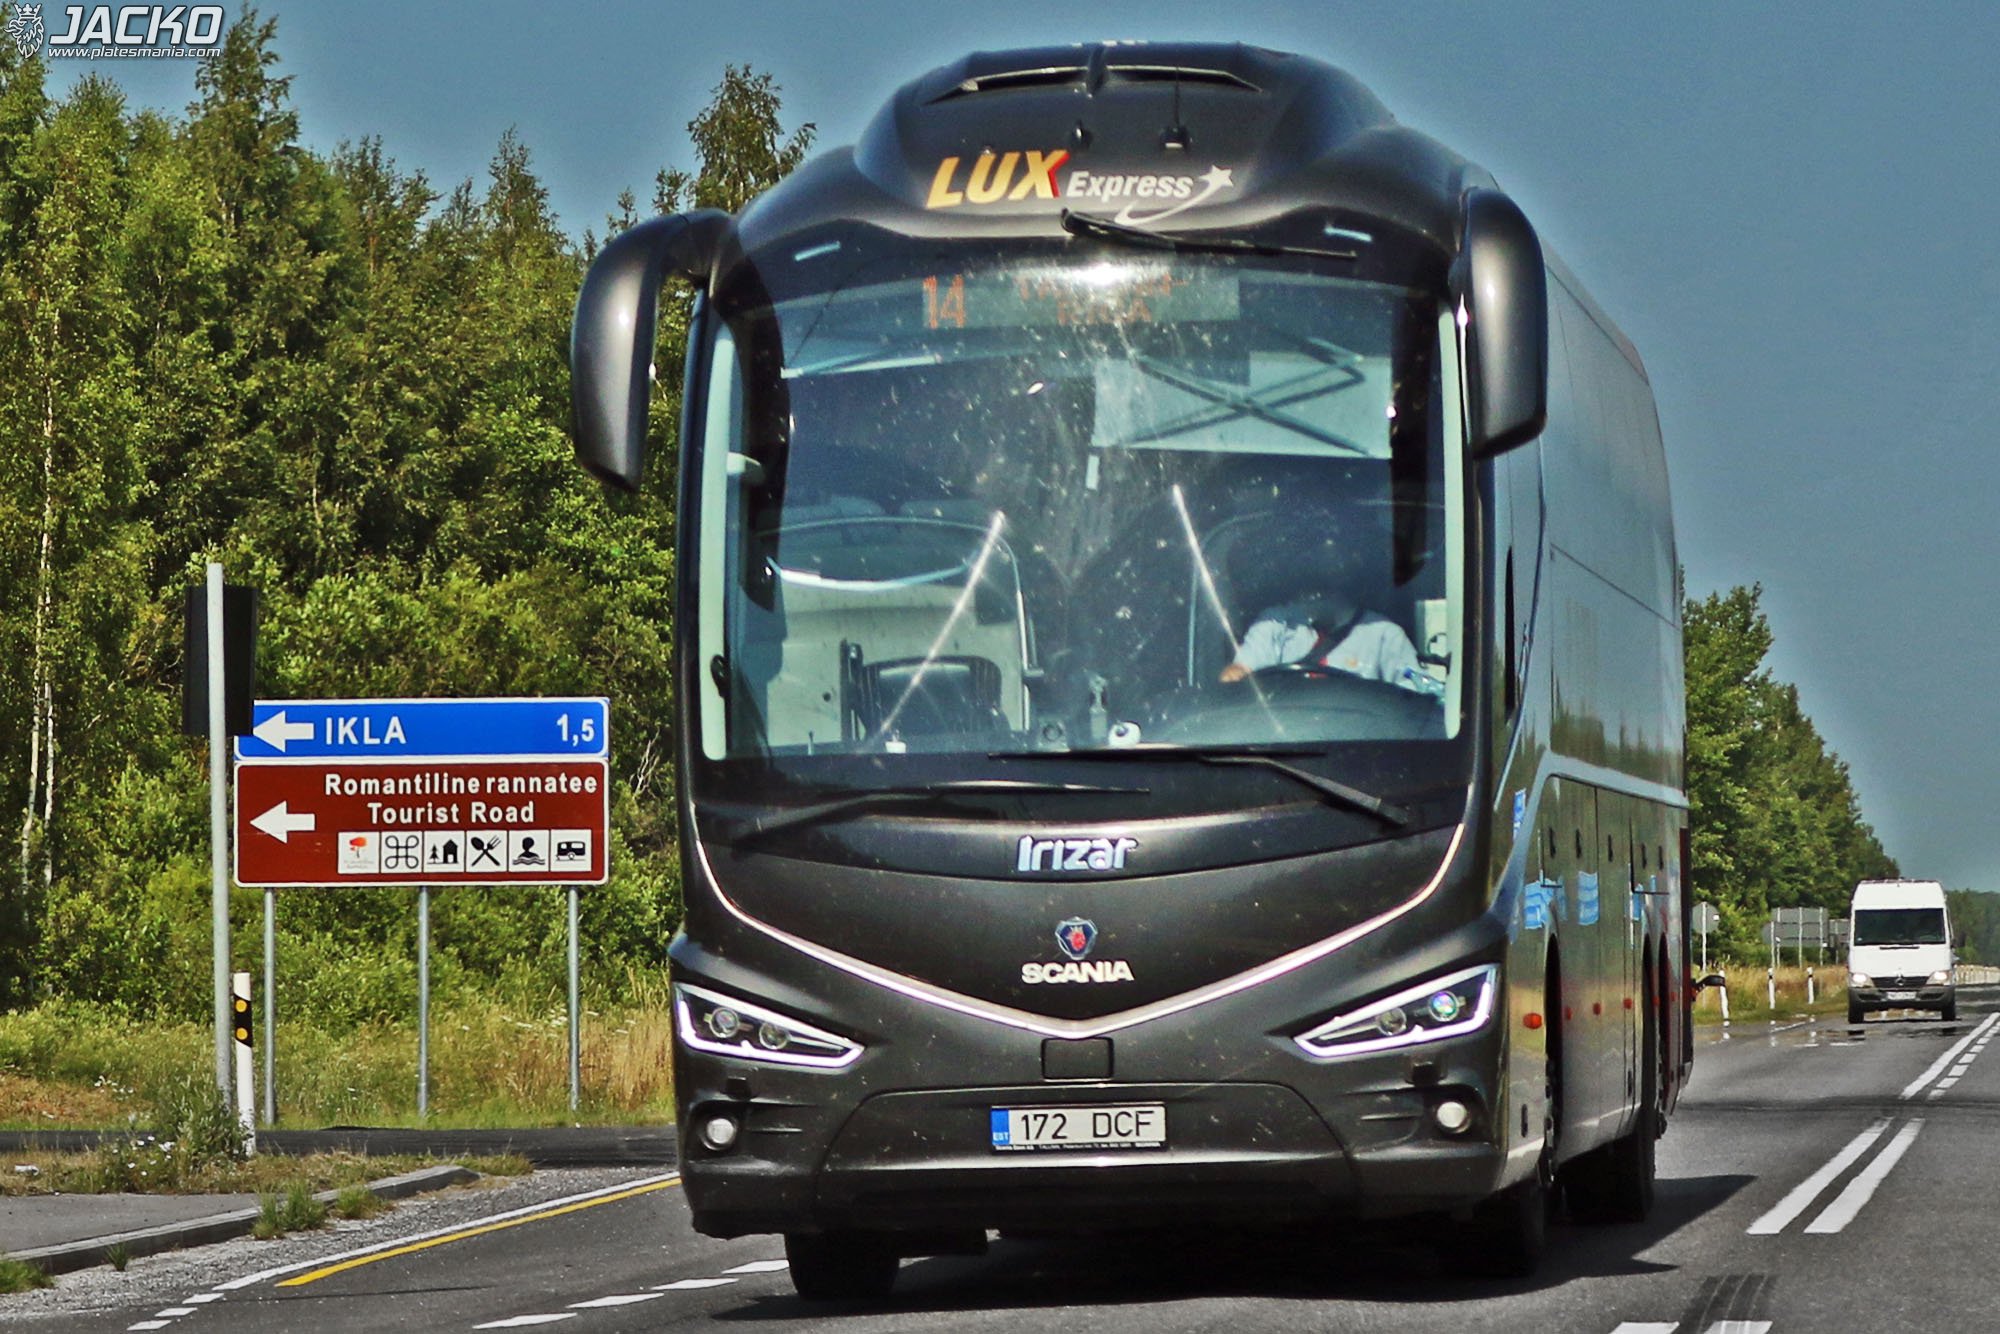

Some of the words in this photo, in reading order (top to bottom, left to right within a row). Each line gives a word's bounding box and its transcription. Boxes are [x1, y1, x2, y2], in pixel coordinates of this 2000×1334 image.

[925, 149, 1069, 209] LUX
[1066, 170, 1194, 202] Express
[923, 275, 965, 329] 14
[325, 716, 407, 745] IKLA
[556, 714, 595, 747] 1,5
[325, 773, 480, 796] Romantiline
[486, 772, 598, 794] rannatee
[367, 802, 459, 825] Tourist
[471, 801, 534, 823] Road
[1018, 836, 1138, 872] Irizar
[1021, 960, 1135, 984] SCANIA
[1021, 1113, 1067, 1140] 172
[1092, 1110, 1155, 1138] DCF
